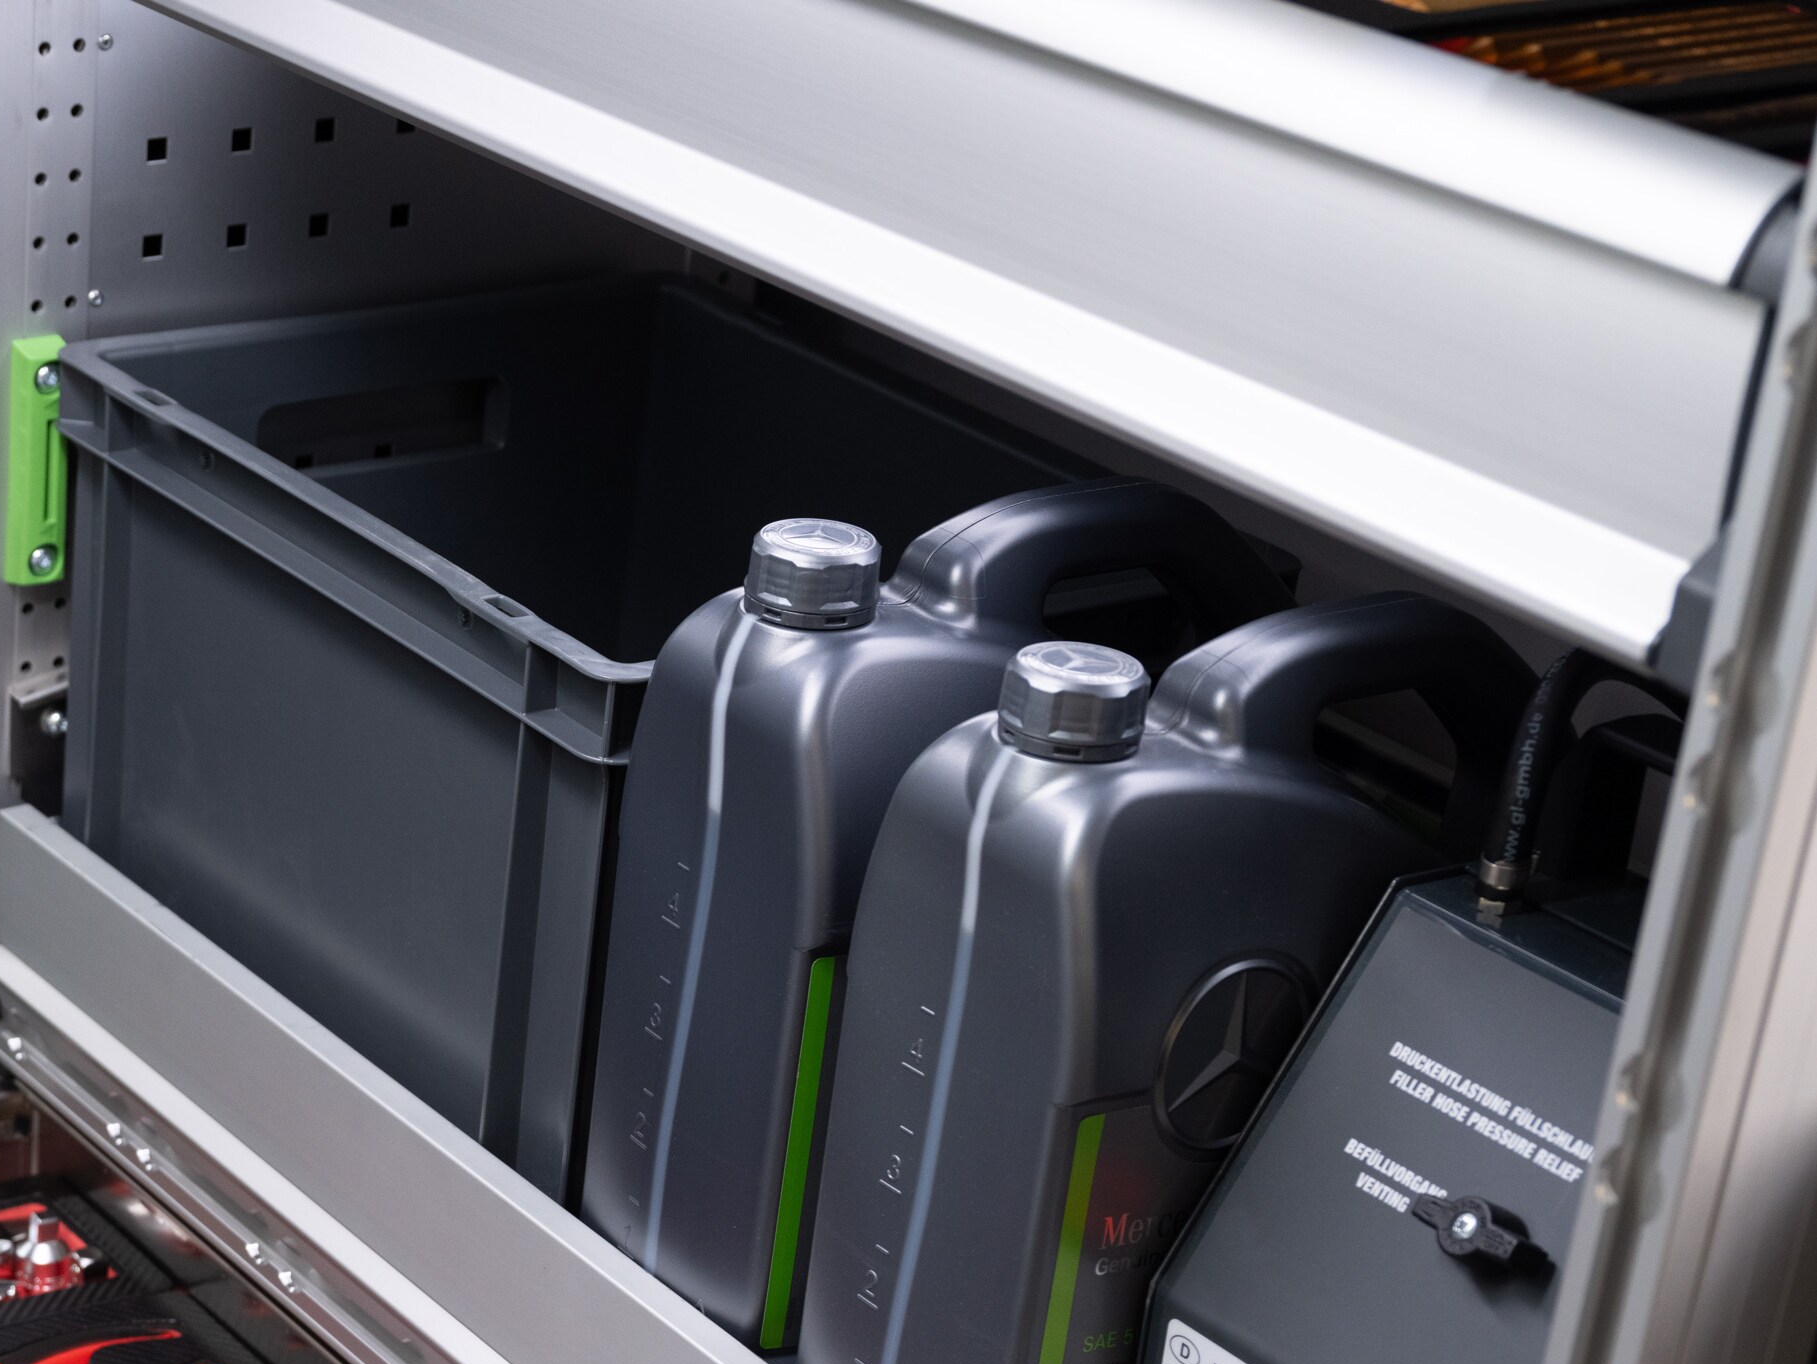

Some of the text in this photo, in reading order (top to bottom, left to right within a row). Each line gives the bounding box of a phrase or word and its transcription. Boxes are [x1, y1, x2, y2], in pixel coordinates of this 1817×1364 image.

[1389, 1041, 1595, 1164] DRUCKENTLASTUNG FÜLLSCHLAU
[1390, 1070, 1584, 1184] FILLER HOSE PRESSURE RELIEF
[886, 1154, 902, 1180] 3
[1355, 1172, 1410, 1213] VENTING
[863, 1269, 879, 1297] 2
[1083, 1331, 1118, 1354] SAE
[1179, 1342, 1190, 1361] D
